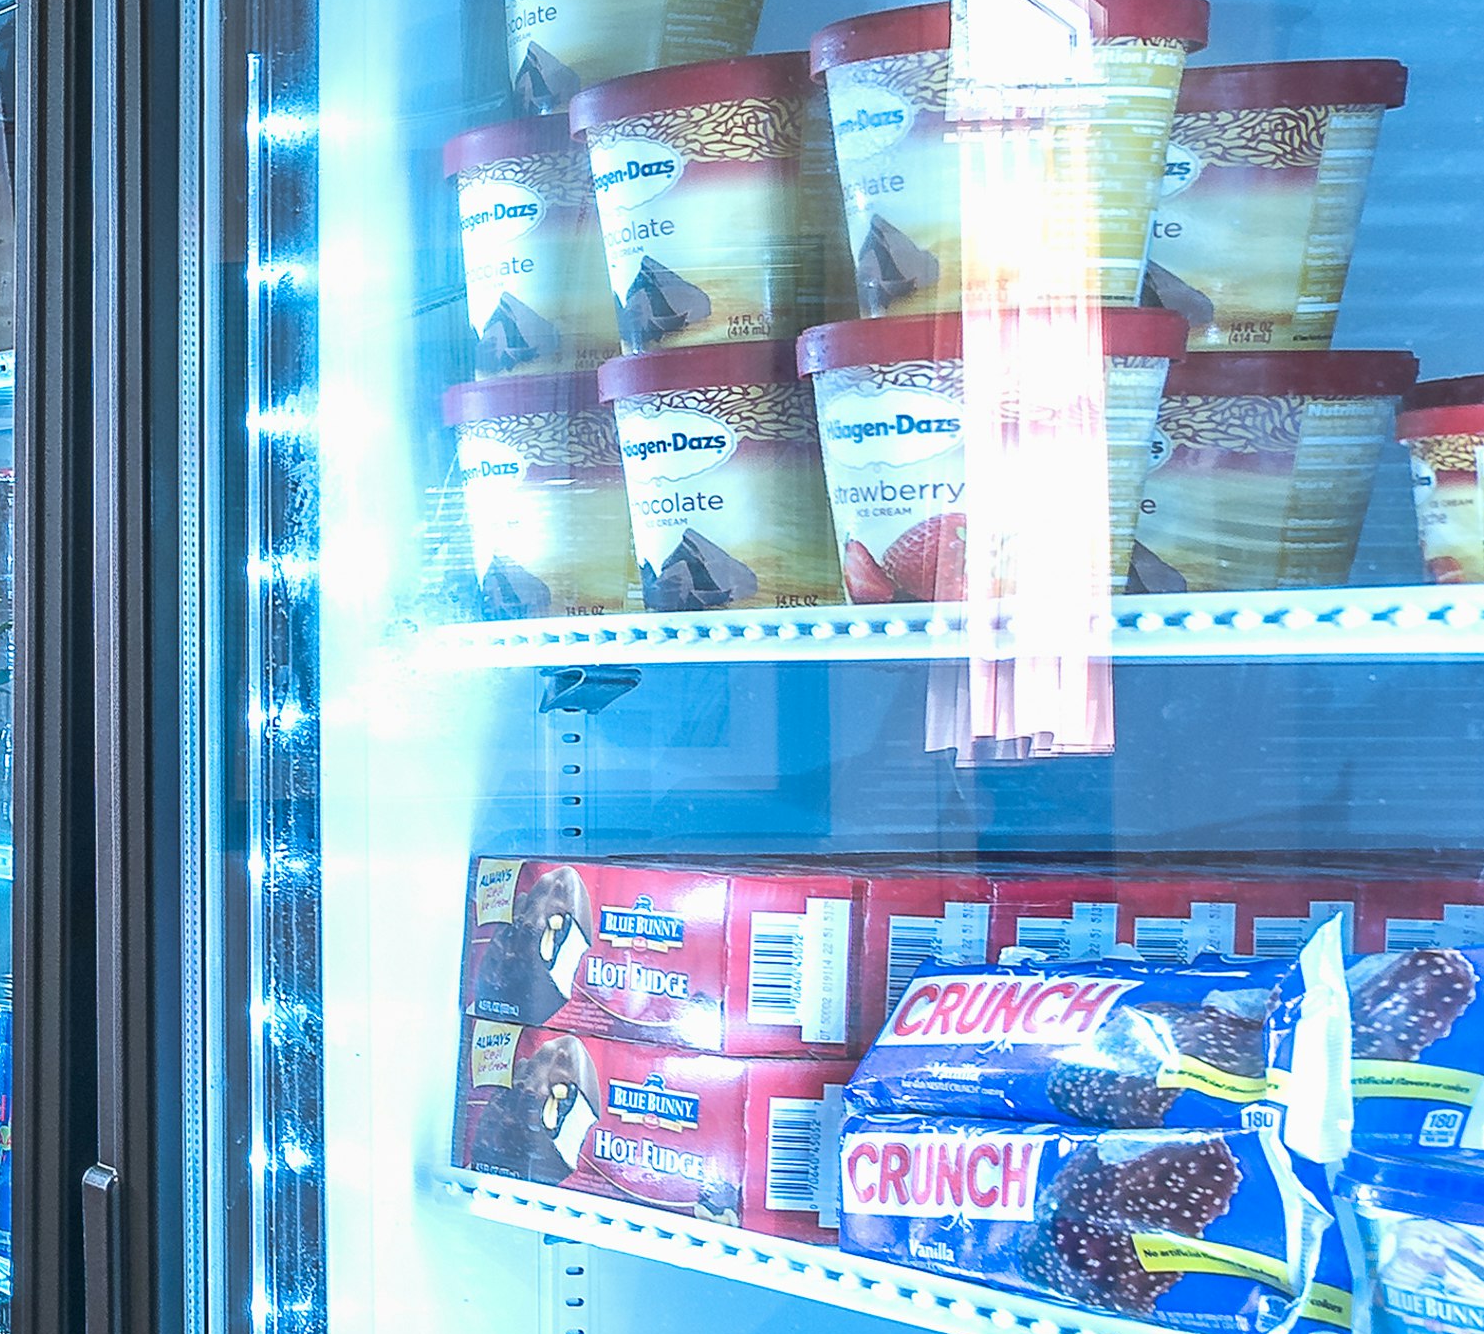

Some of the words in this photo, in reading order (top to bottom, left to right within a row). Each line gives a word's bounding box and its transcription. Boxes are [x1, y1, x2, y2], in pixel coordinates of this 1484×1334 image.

[834, 479, 966, 505] strawberry
[872, 507, 913, 517] CREAM
[605, 912, 636, 935] BLUE
[636, 914, 681, 938] BUNNY
[586, 956, 630, 990] HOT
[629, 961, 690, 1000] FUDGE
[893, 981, 1123, 1038] CRUNCH
[1351, 1076, 1395, 1087] rtificial
[614, 1088, 646, 1111] BLUE
[647, 1091, 695, 1120] BUNNY
[1245, 1110, 1274, 1129] 180
[1427, 1113, 1458, 1130] 180
[594, 1128, 638, 1165] HOT
[640, 1137, 706, 1182] FUDGE
[847, 1141, 1036, 1208] CRUNCH
[908, 1239, 955, 1263] Vanilla
[1425, 1296, 1484, 1326] BUNN
